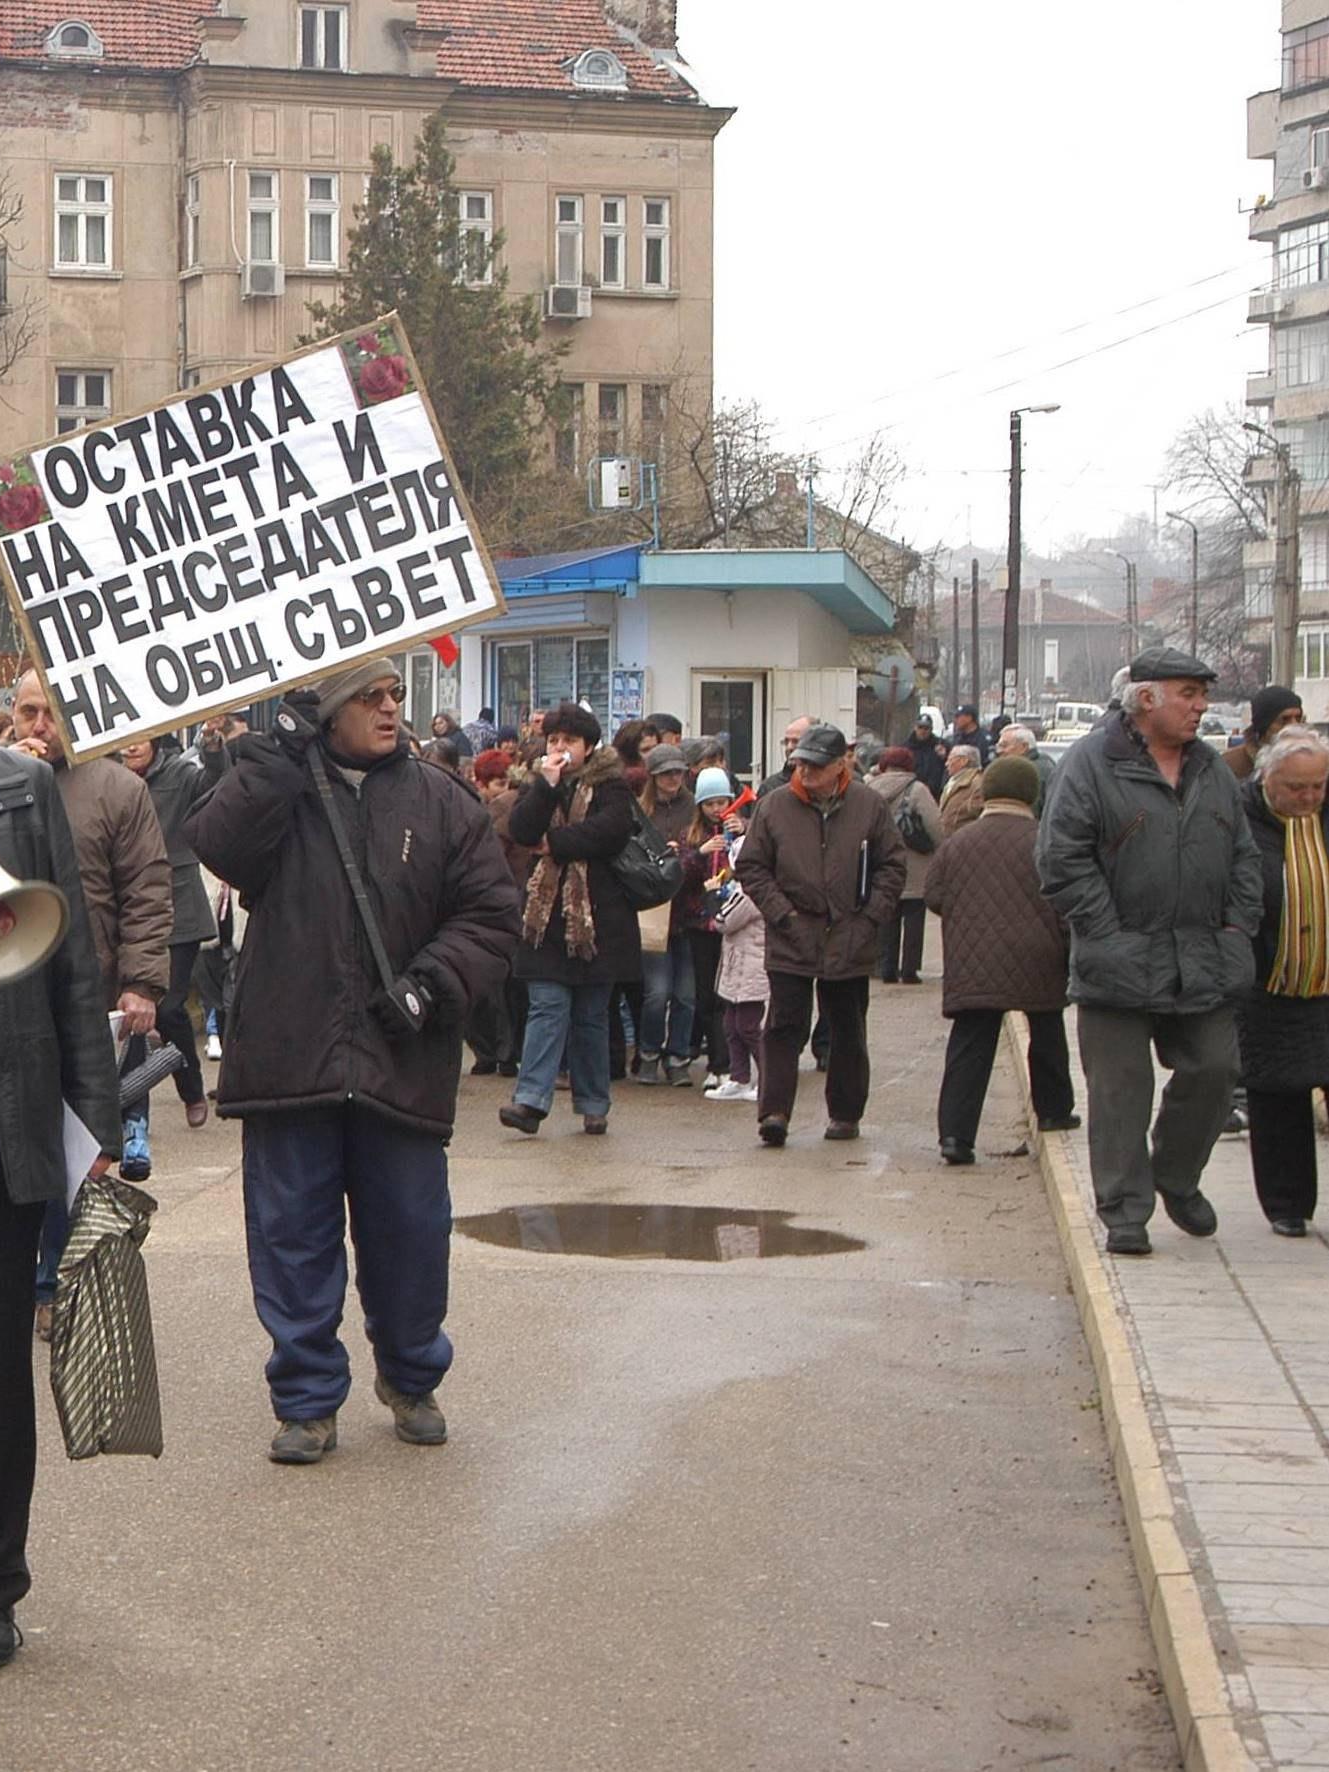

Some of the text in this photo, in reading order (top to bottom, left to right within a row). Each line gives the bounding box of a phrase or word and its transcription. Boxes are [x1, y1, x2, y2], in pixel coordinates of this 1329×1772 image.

[3, 413, 387, 602] НА КМЕТА И
[45, 367, 315, 509] ОСТАВКА
[25, 459, 464, 669] ПРЕДСЕДАТЕЛЯ
[51, 535, 477, 743] НА ОБЩ. СЪВЕТ
